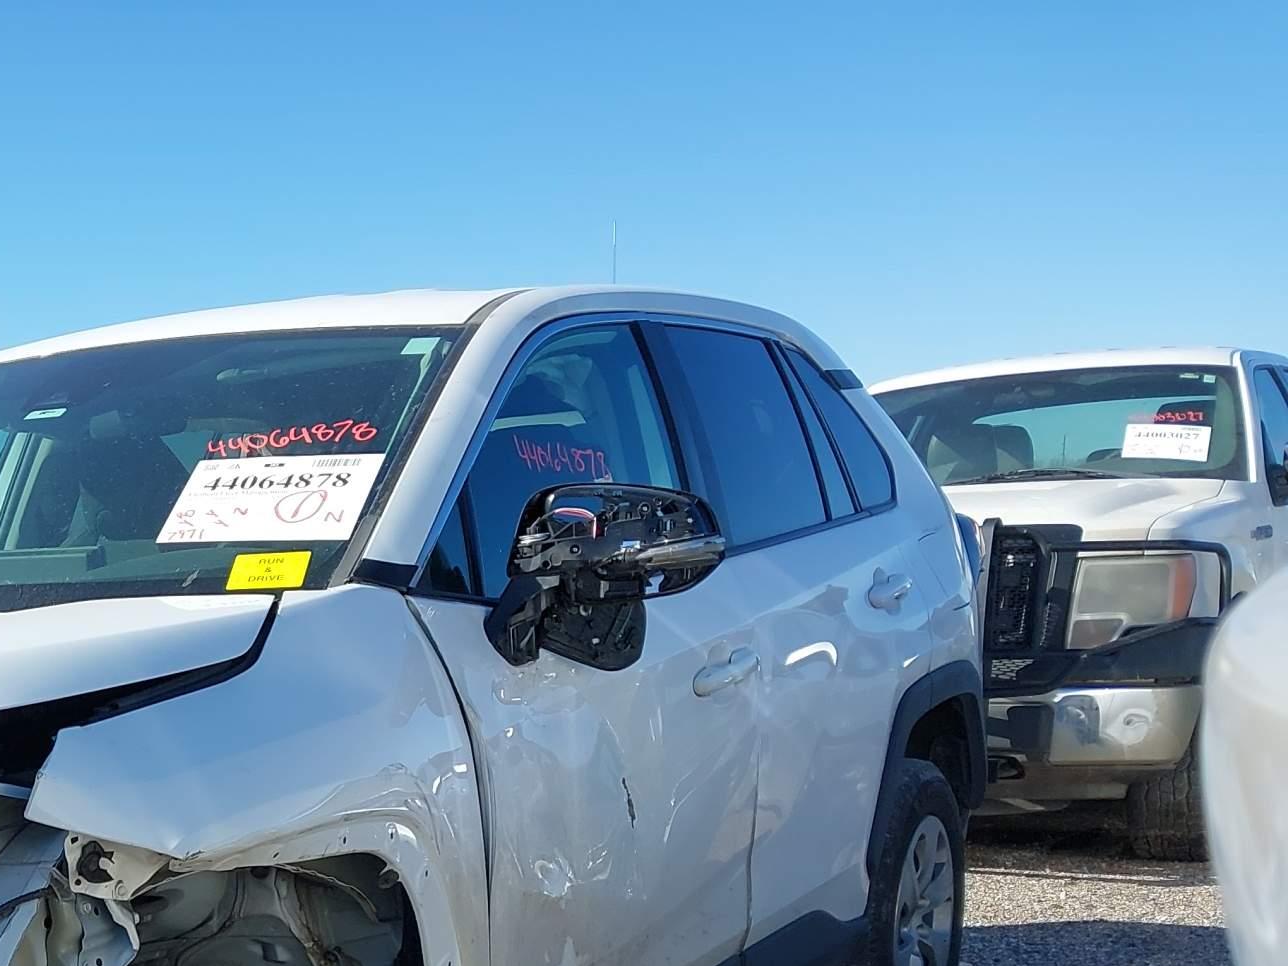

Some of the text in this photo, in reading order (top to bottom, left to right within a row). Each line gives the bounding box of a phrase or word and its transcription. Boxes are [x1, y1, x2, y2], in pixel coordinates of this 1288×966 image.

[207, 419, 377, 458] 44064878
[204, 472, 352, 491] 44064878
[258, 557, 285, 566] RUN
[247, 574, 285, 583] DRIVE
